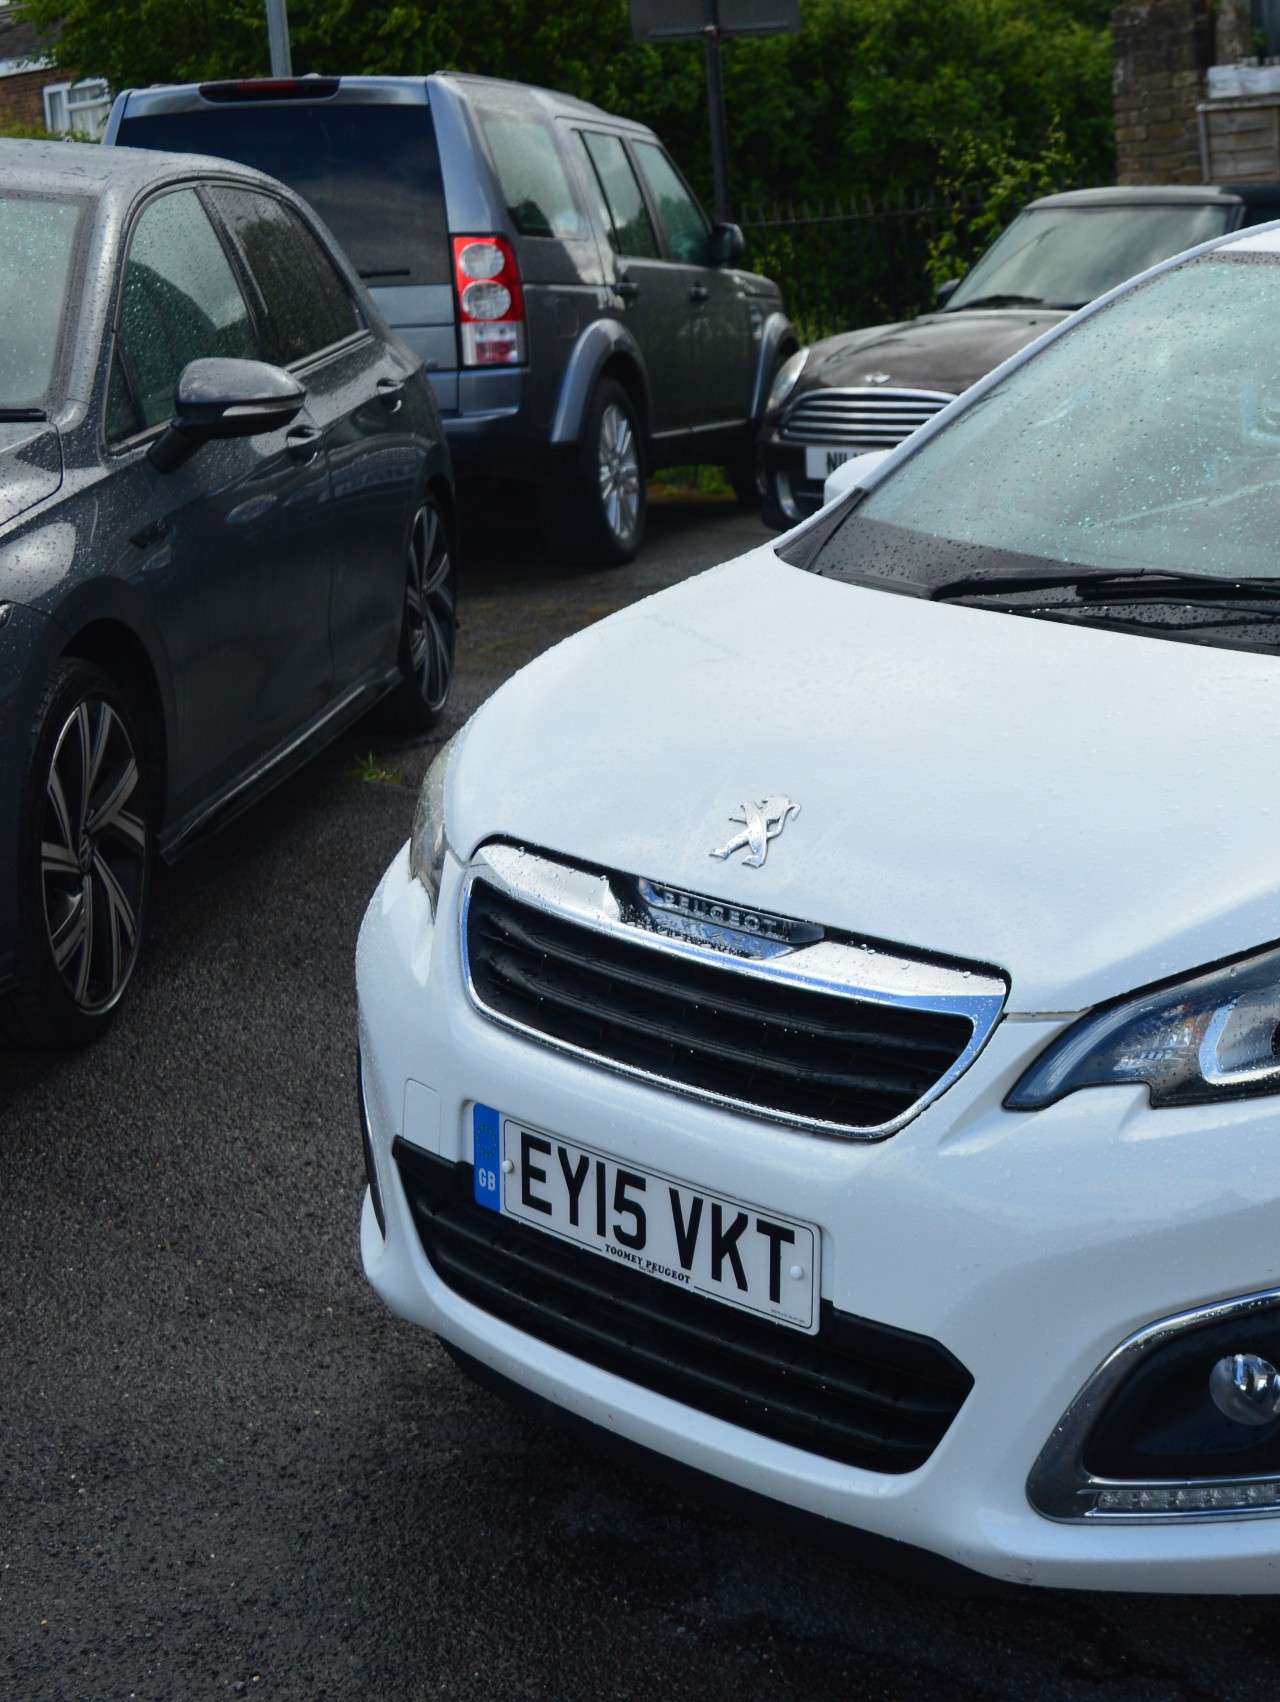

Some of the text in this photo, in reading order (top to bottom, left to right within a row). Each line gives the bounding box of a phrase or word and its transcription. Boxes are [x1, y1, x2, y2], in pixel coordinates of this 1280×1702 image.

[662, 890, 779, 937] PEUGEOT
[477, 1166, 497, 1192] GB
[520, 1131, 796, 1305] EY15 VKT
[604, 1242, 691, 1285] TOOMEY PEUGEOT
